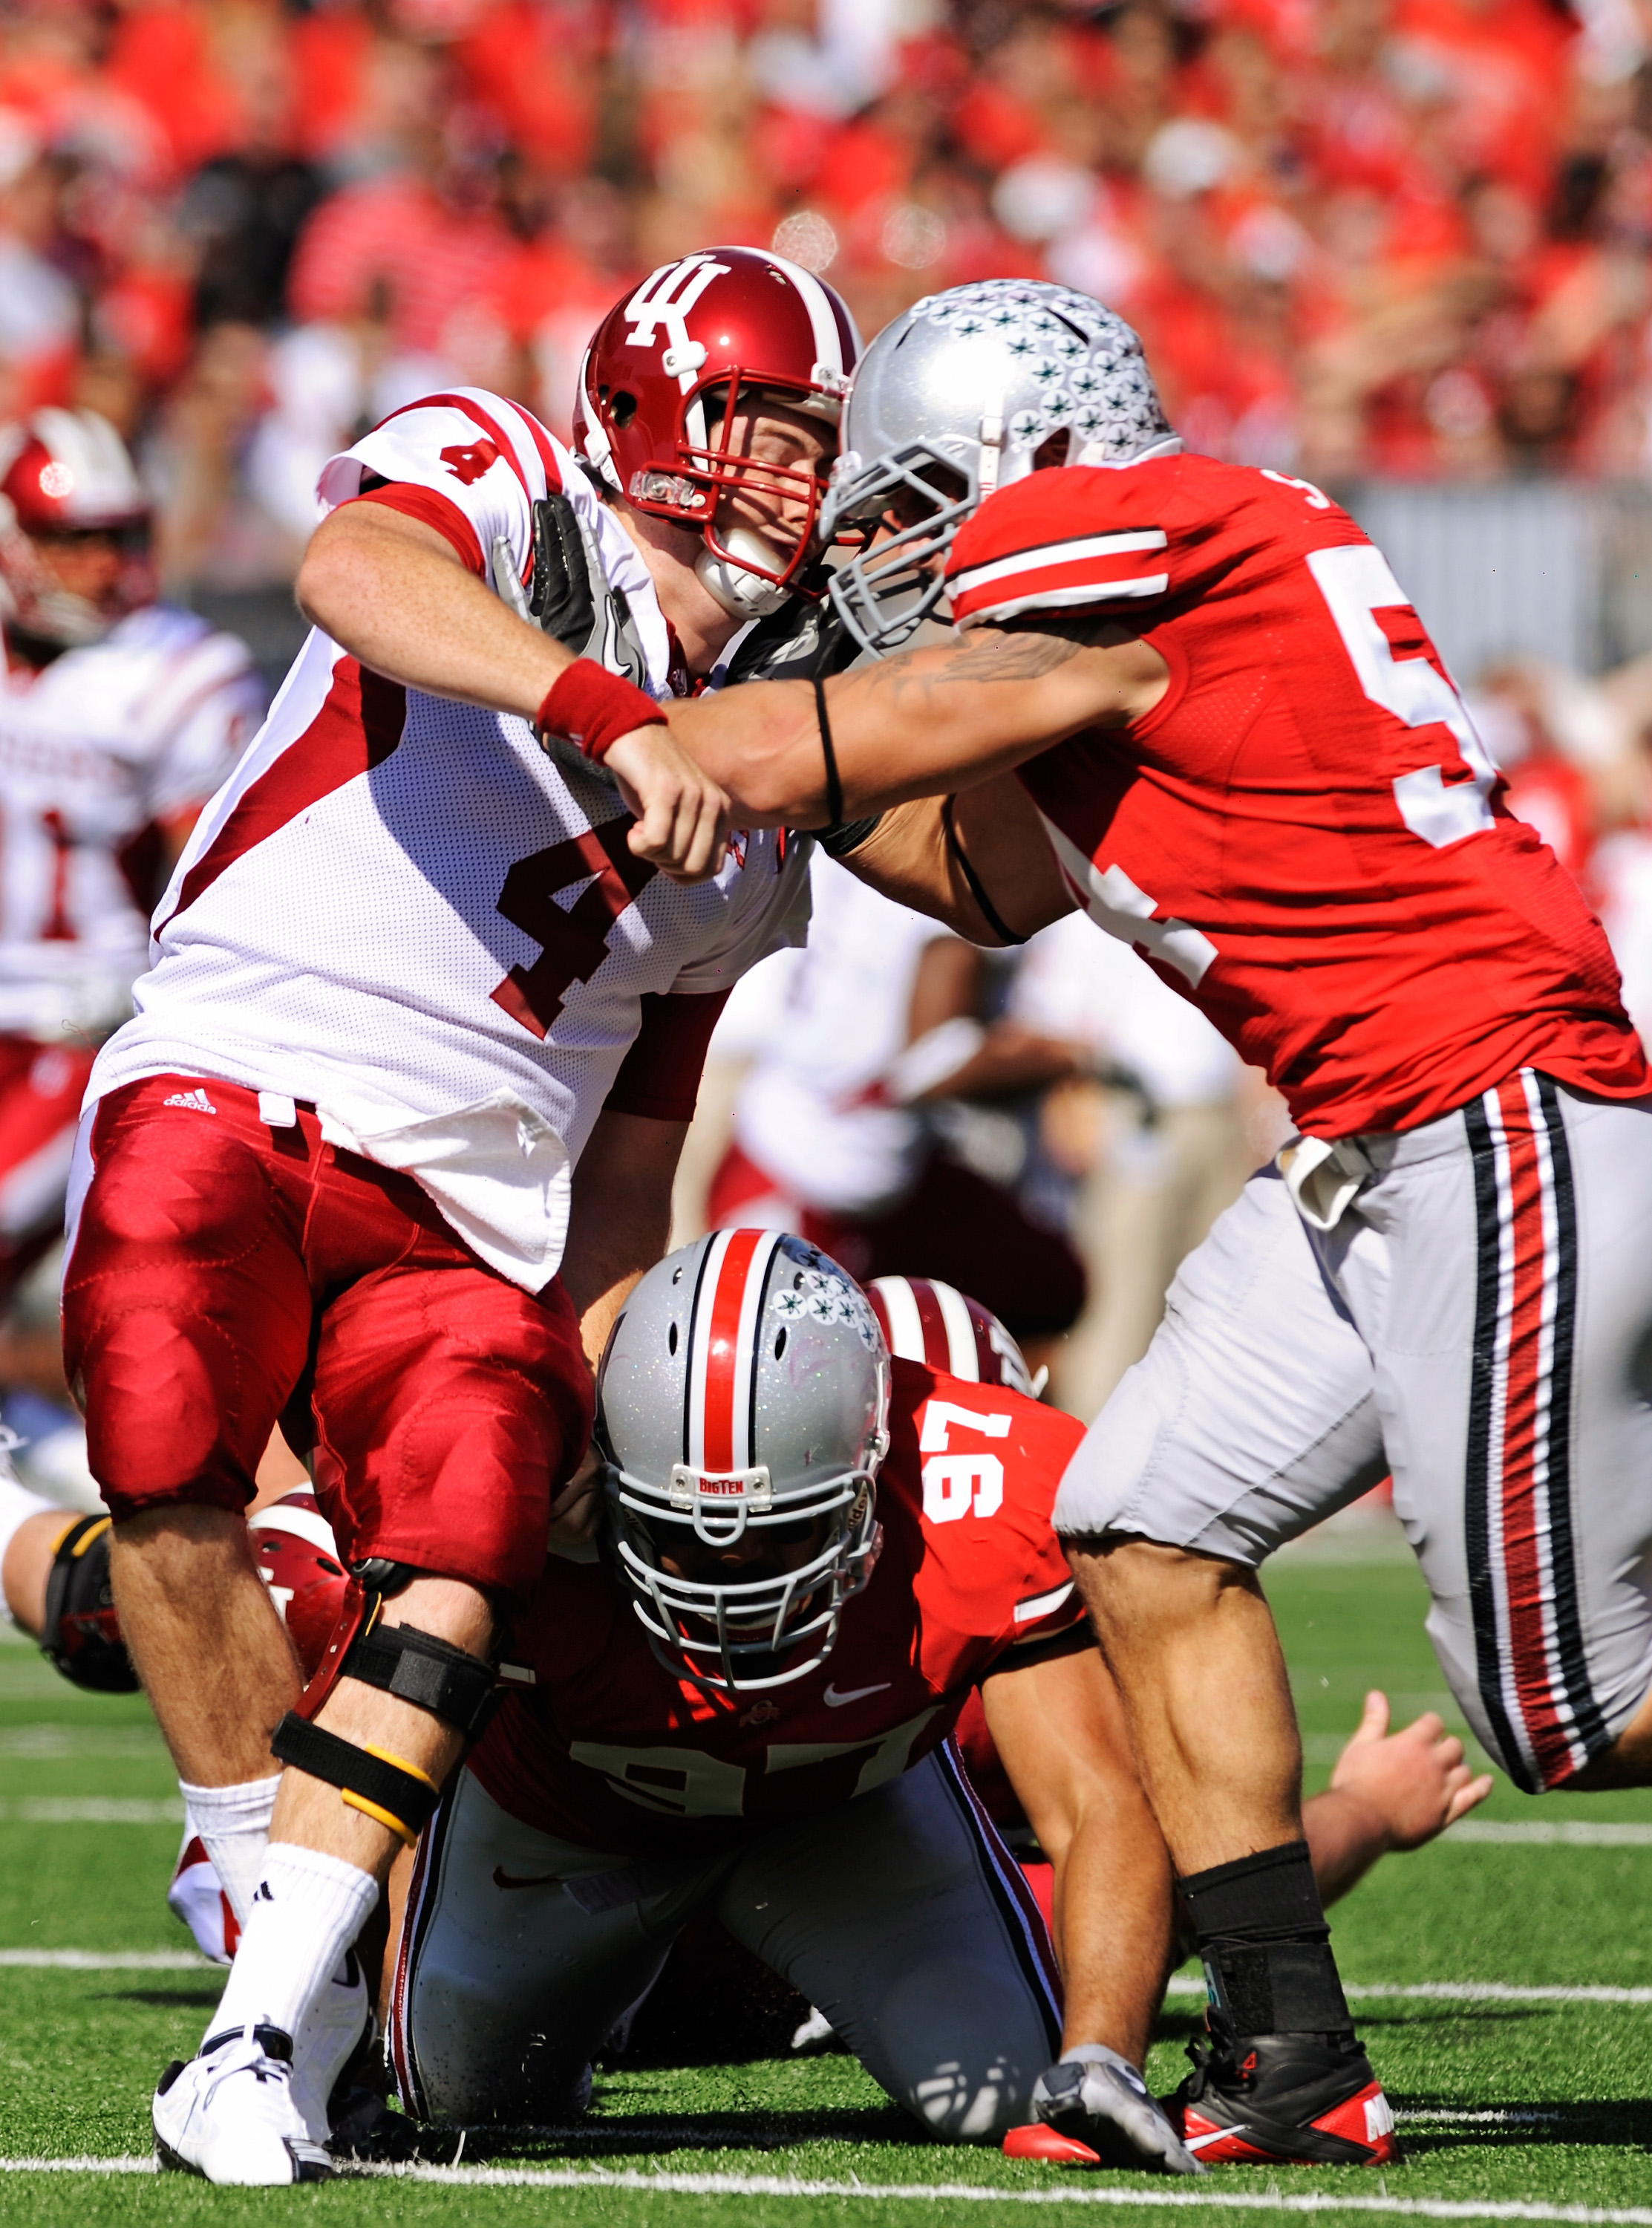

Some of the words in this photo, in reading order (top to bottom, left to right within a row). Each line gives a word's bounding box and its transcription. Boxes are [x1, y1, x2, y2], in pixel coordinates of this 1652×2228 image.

[439, 437, 500, 486] 4
[1305, 544, 1502, 849] 5
[489, 810, 662, 1041] 4
[163, 1098, 217, 1115] adidas
[919, 1399, 1013, 1525] 97
